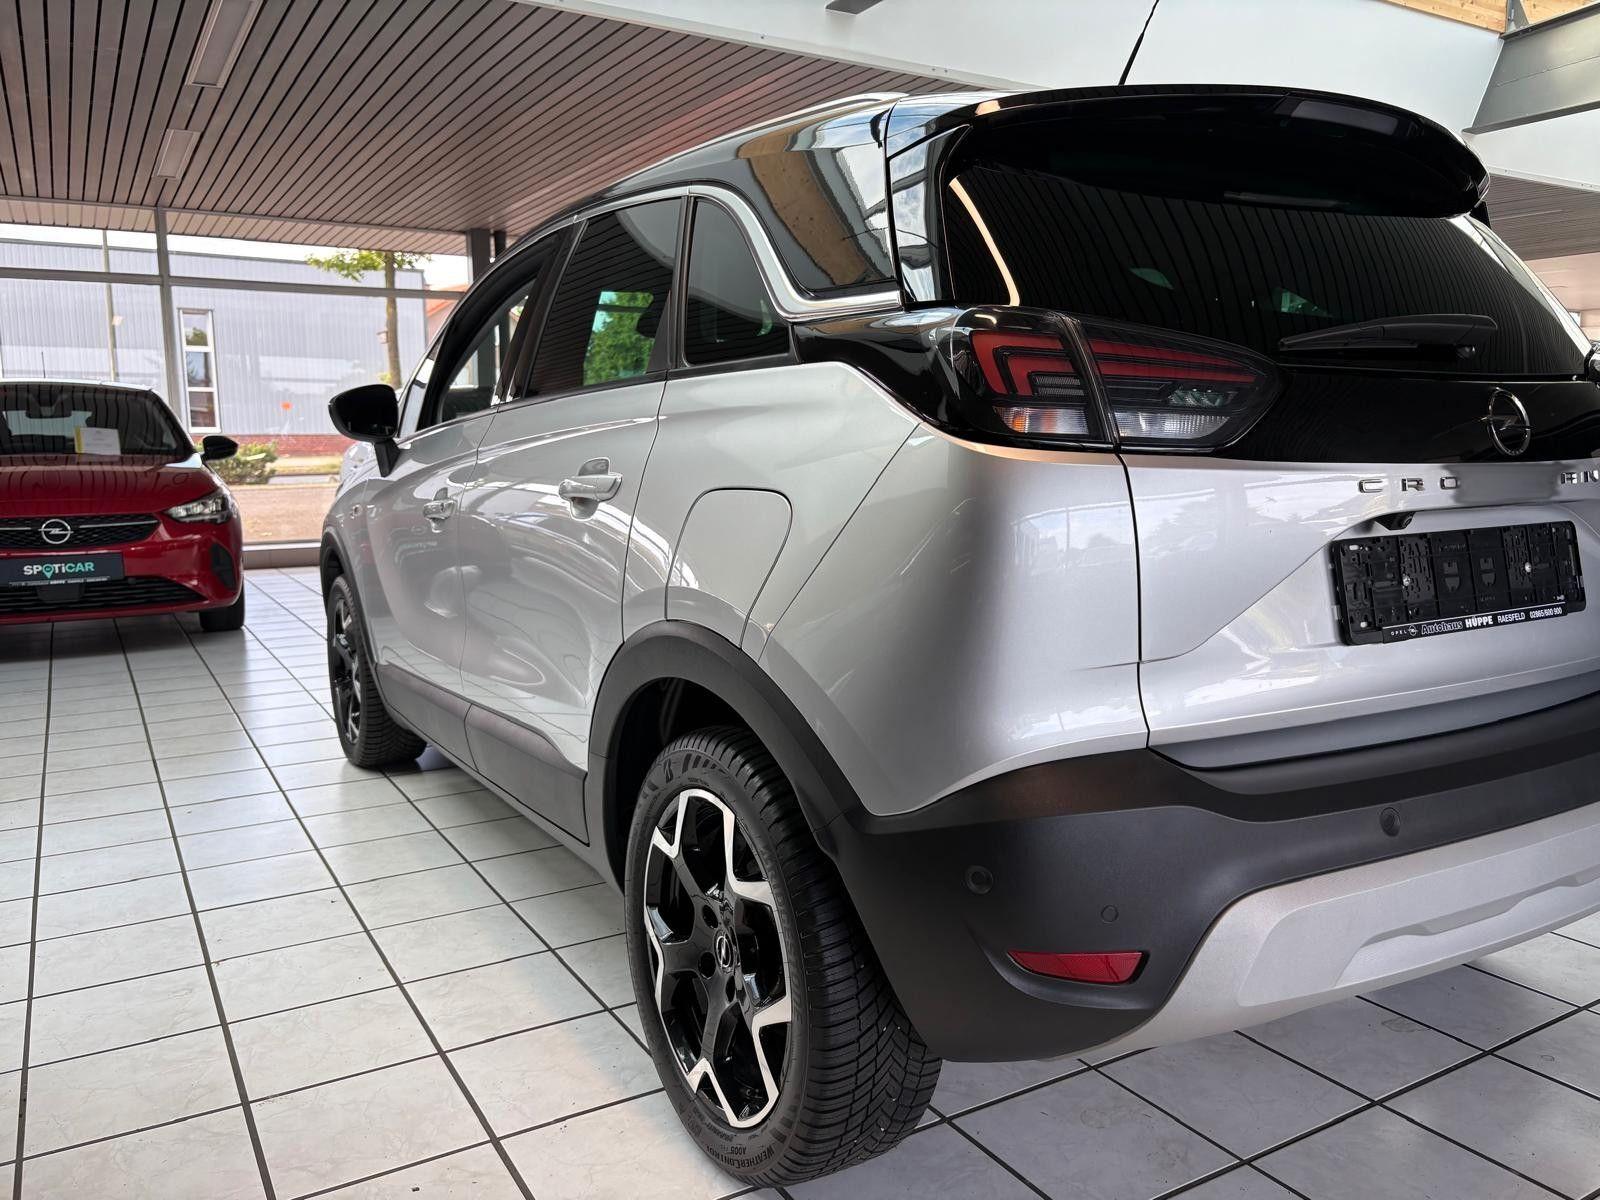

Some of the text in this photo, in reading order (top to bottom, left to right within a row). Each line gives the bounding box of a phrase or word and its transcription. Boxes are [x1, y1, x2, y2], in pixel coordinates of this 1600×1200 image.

[1421, 620, 1463, 635] Autohaus
[1465, 615, 1494, 629] HÜPPE
[1498, 612, 1526, 624] RAESFELD
